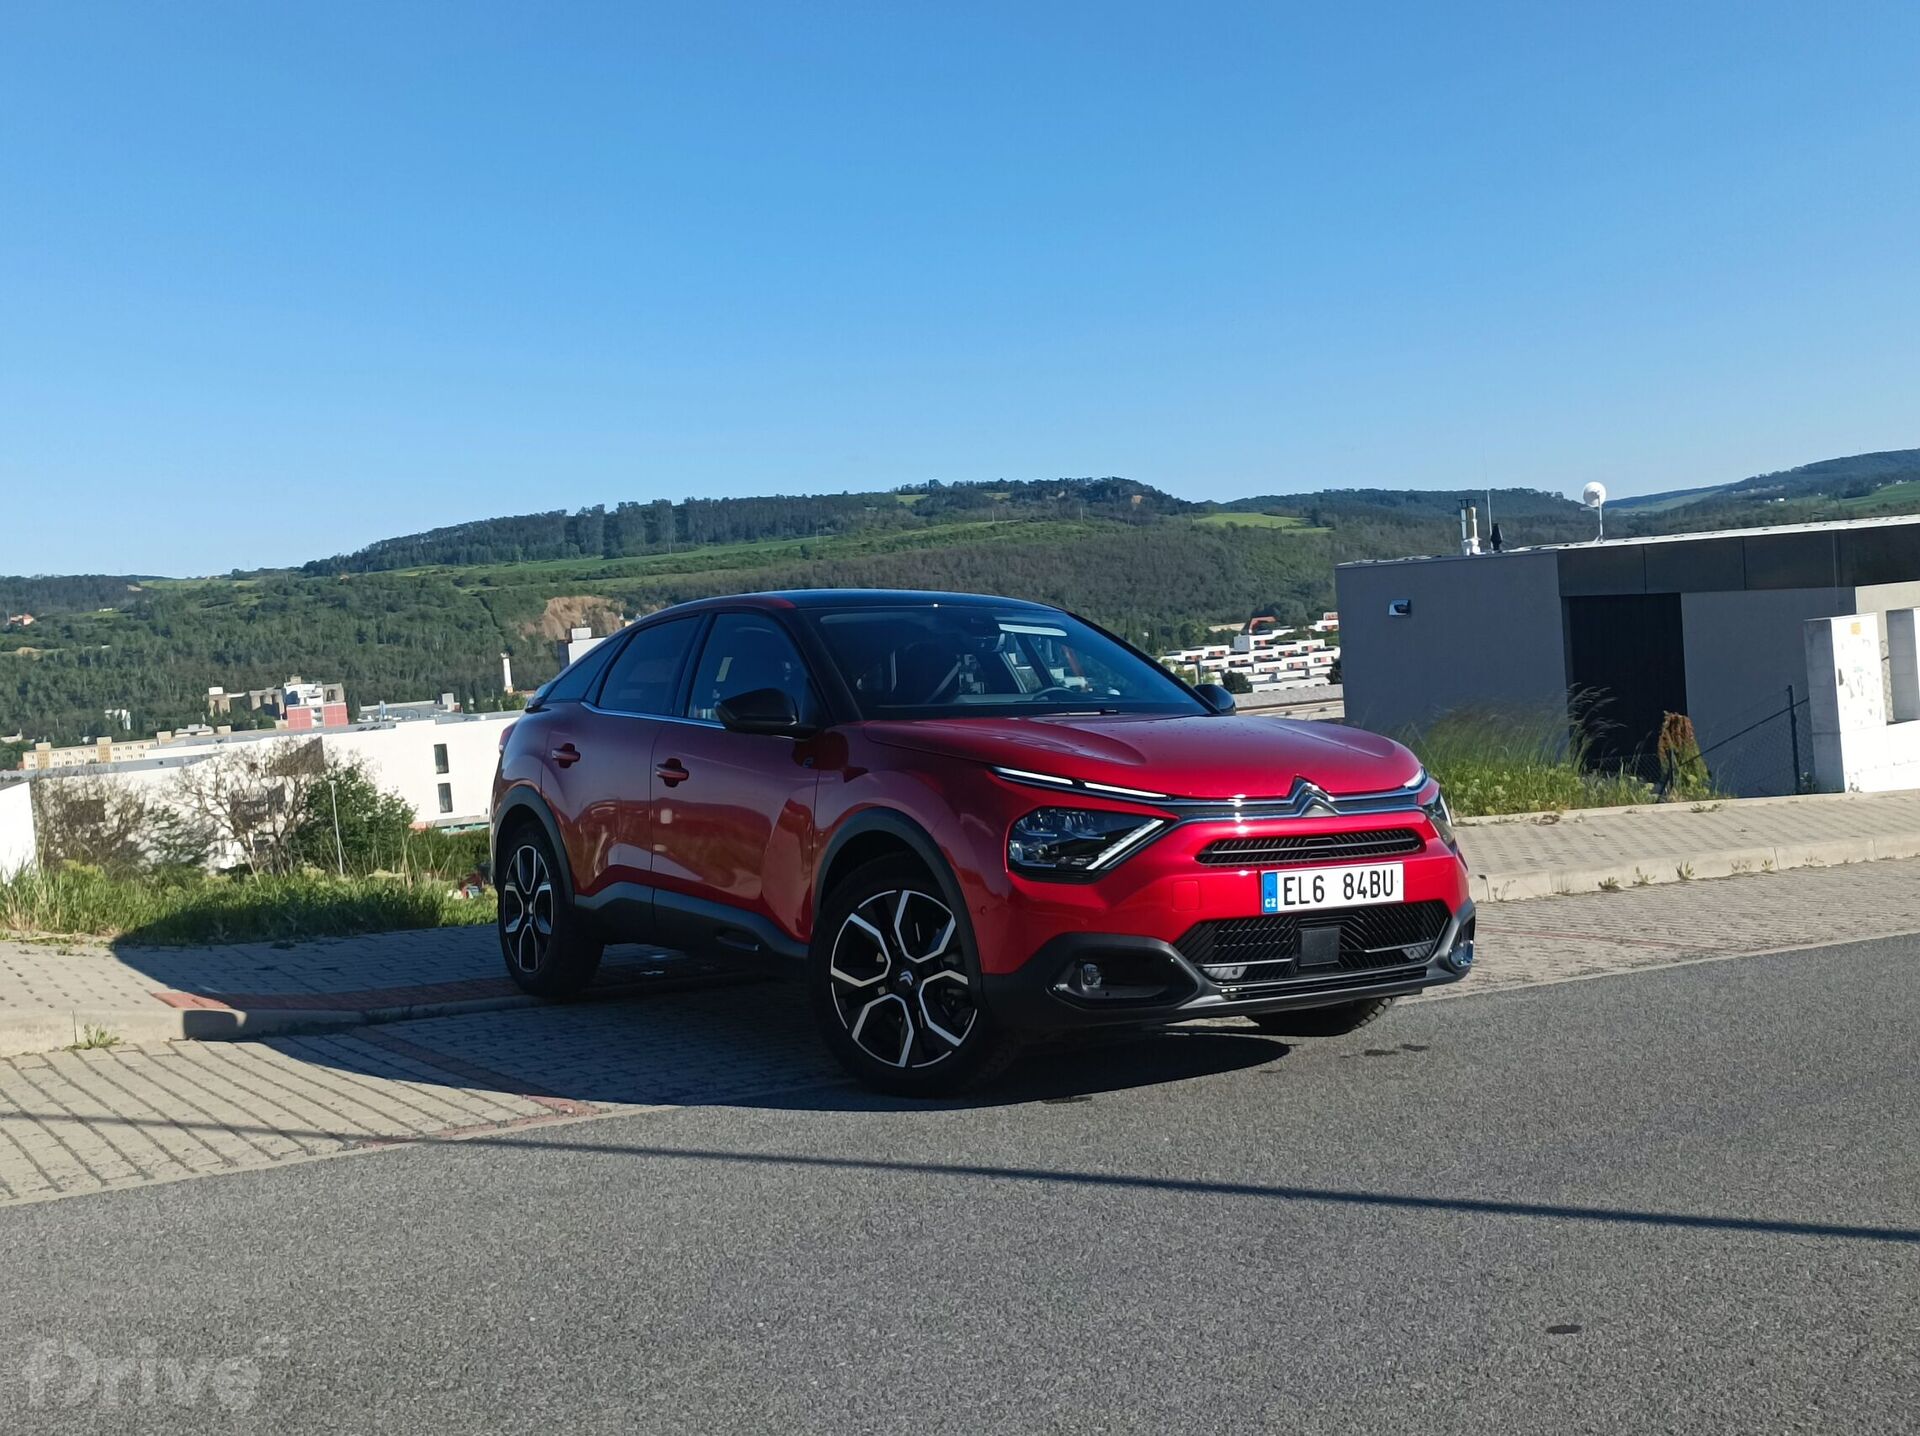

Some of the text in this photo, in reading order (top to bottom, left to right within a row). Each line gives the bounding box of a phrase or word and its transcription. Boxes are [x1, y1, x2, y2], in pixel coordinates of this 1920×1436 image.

[1264, 869, 1394, 908] CZ EL6 84BU
